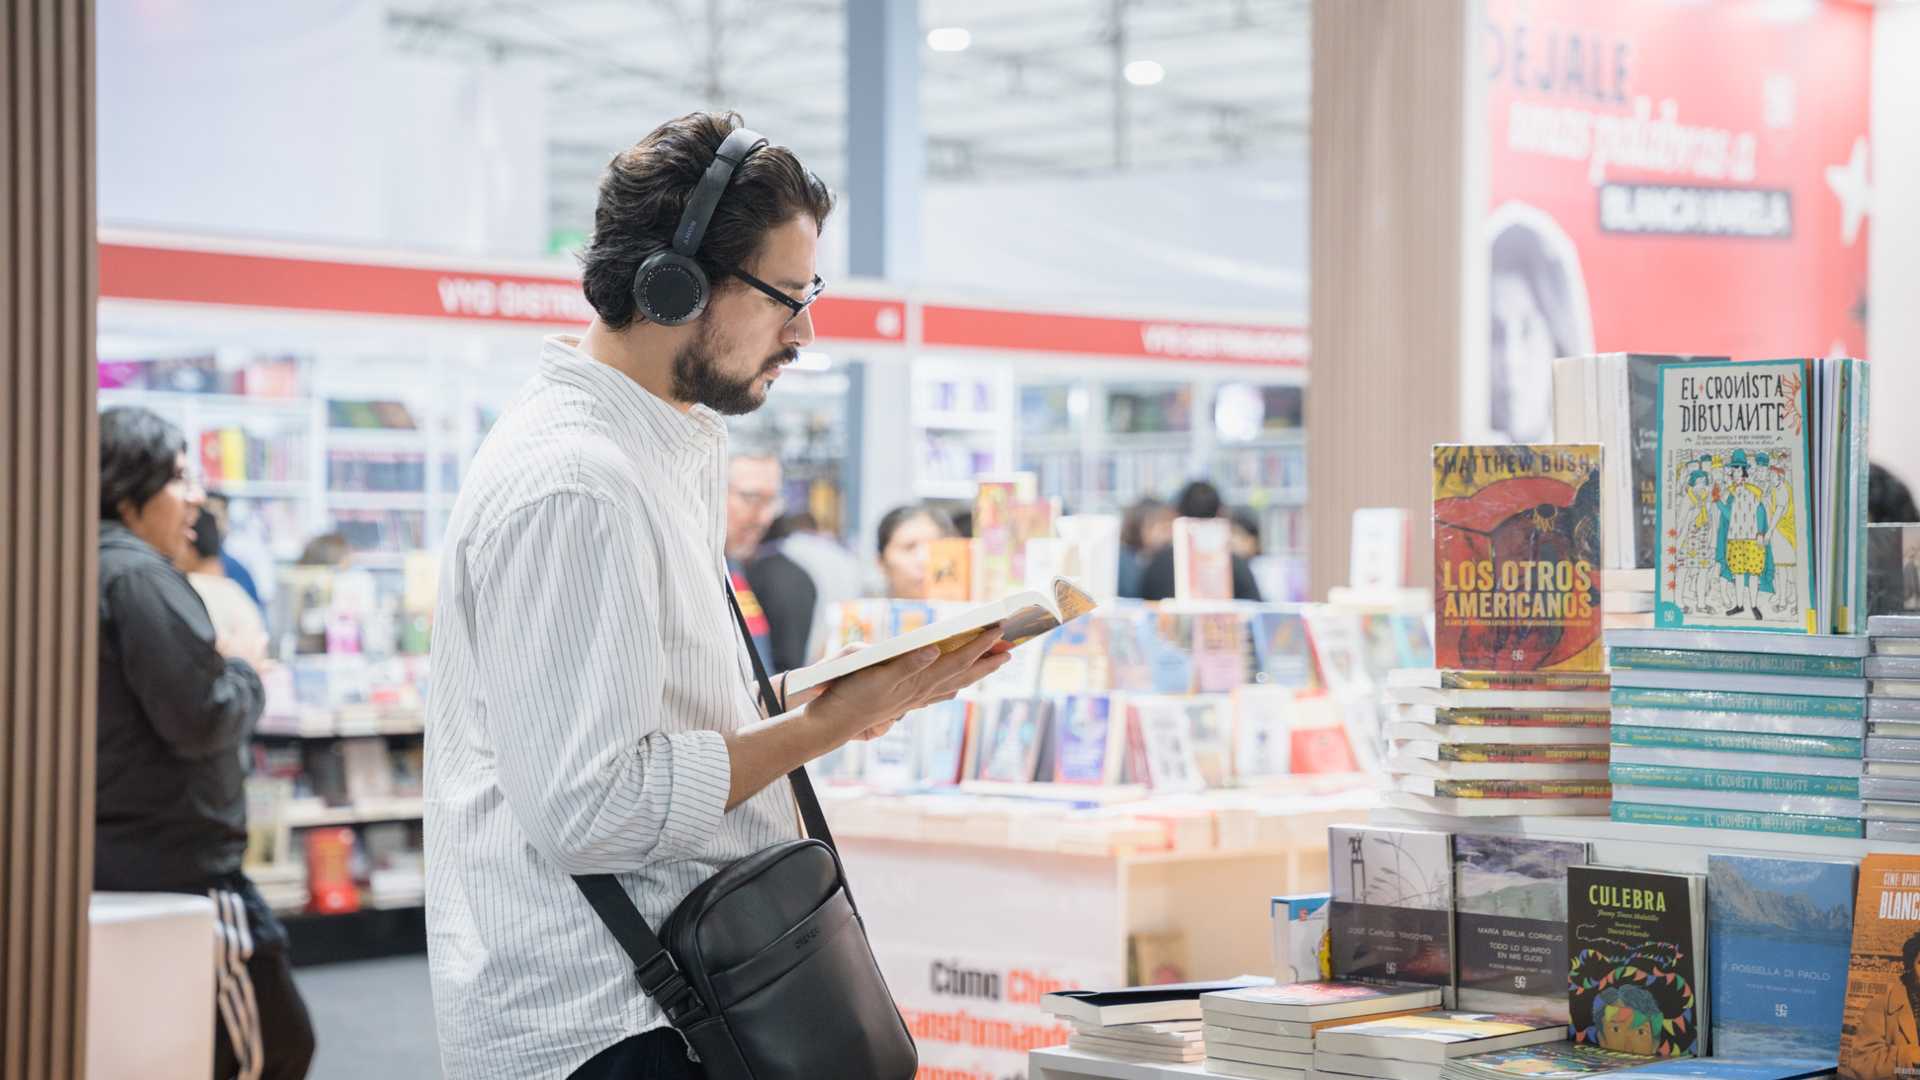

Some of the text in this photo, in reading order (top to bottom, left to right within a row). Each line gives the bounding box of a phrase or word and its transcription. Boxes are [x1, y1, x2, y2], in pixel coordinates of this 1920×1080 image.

[1681, 371, 1785, 400] EL CRONISTA
[1679, 401, 1786, 433] DIBUJANTE
[1442, 453, 1591, 473] MATTHEW BUSH
[1443, 559, 1592, 592] LOS OTROS
[1443, 592, 1593, 619] AMERICANOS
[1704, 774, 1714, 787] EL
[1716, 775, 1758, 790] CRONISTA
[1760, 777, 1809, 792] DIBUJANTE
[1704, 814, 1714, 827] EL
[1716, 815, 1758, 830] CRONISTA
[1760, 817, 1807, 832] DIBUJANTE
[1588, 884, 1666, 912] CULEBRA
[1879, 891, 1920, 921] BLANC
[1368, 928, 1396, 938] CARLOS
[1502, 929, 1526, 938] EMILIA
[1527, 932, 1564, 942] CORNEJO
[1489, 942, 1552, 955] TODO LO GUARDO
[1497, 951, 1543, 962] EN MIS OJOS
[1729, 962, 1832, 981] ROSSELLA DI PAOLO
